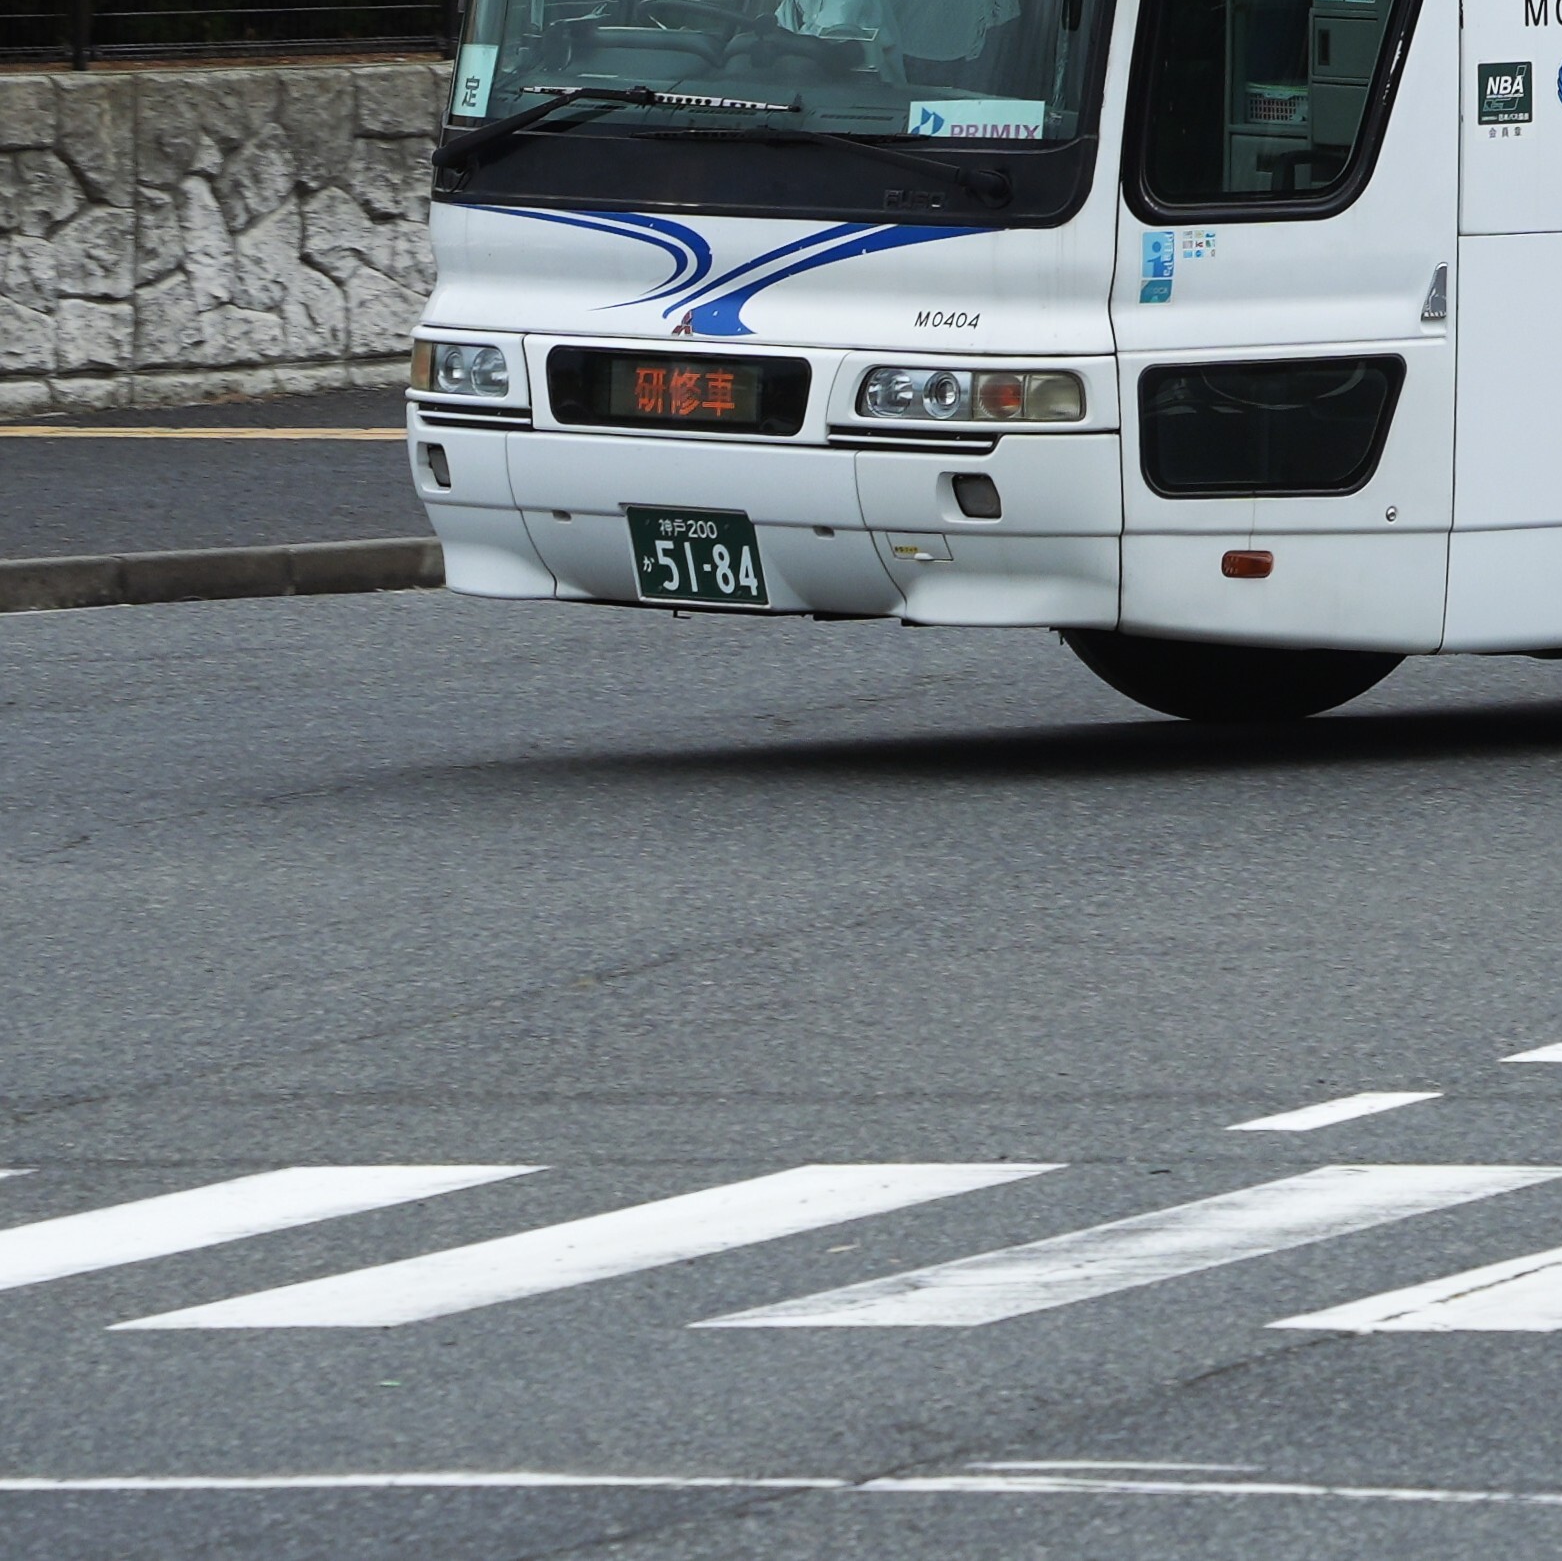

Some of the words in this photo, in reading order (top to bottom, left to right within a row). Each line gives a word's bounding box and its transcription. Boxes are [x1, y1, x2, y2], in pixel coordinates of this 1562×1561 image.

[461, 75, 480, 108] 定
[1486, 75, 1524, 95] NBA
[950, 124, 1041, 139] PRIMIX
[914, 310, 981, 329] M0404
[634, 367, 735, 417] 研修車
[643, 555, 655, 573] か
[655, 540, 758, 596] 51-84
